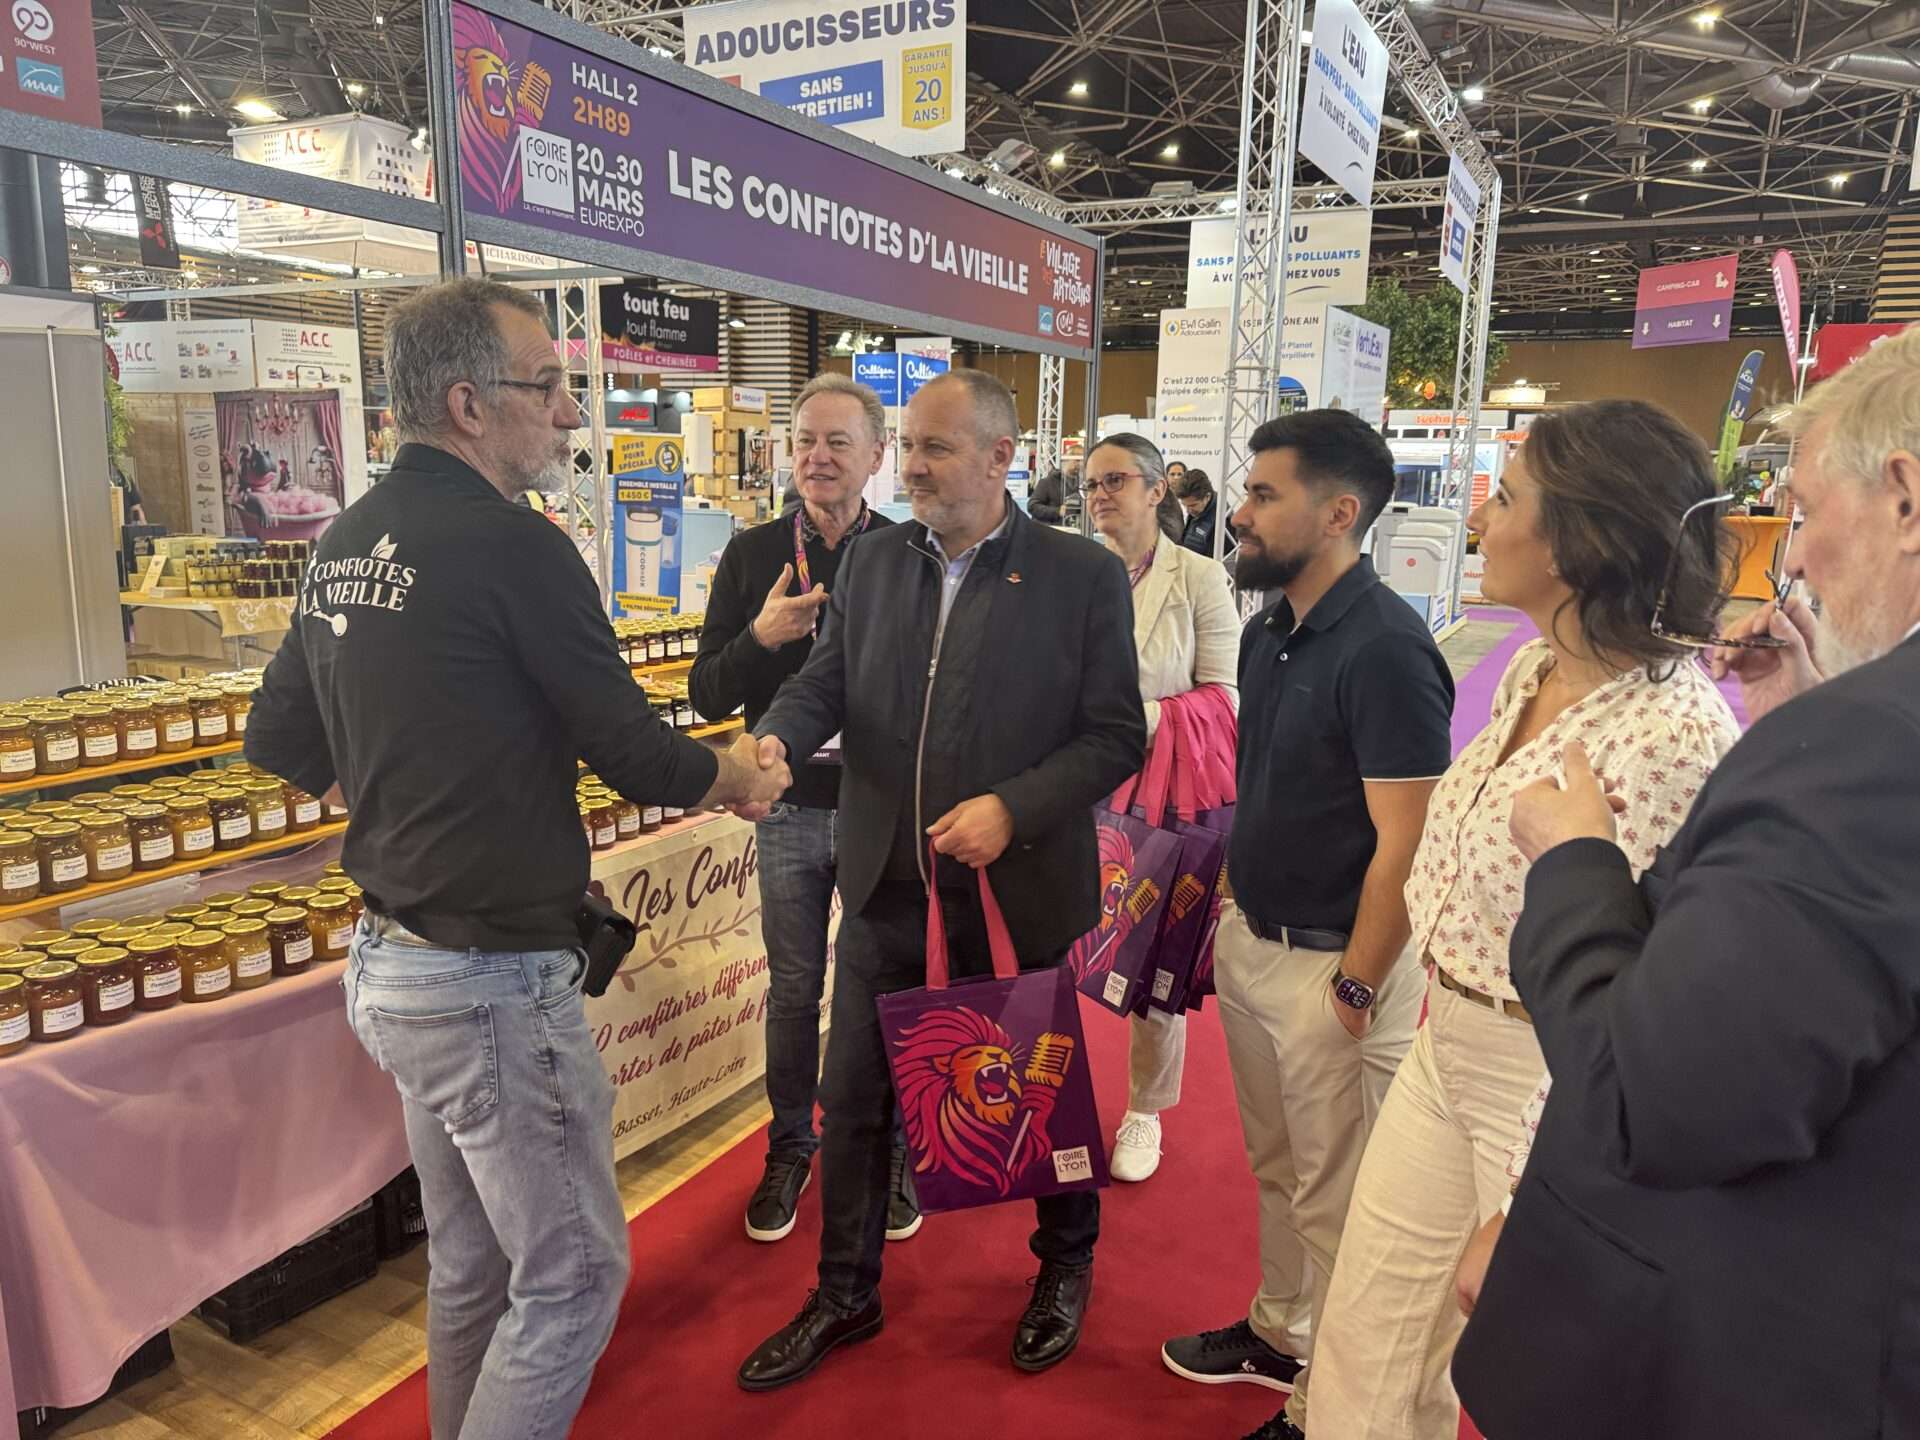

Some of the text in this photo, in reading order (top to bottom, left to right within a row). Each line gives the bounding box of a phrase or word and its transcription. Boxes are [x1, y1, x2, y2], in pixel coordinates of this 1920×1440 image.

[695, 0, 956, 66] ADOUCISSEURS
[904, 48, 950, 63] GARANTIE
[1342, 24, 1368, 79] L'EAU
[572, 62, 639, 106] HALL 2
[800, 76, 843, 98] SANS
[915, 79, 942, 103] 20
[573, 96, 631, 136] 2H89
[913, 108, 940, 122] ANS
[526, 136, 568, 164] FOIRE
[527, 158, 568, 186] LYON
[578, 176, 645, 217] MARS
[580, 207, 645, 237] EUREXPO
[669, 149, 734, 210] LES
[743, 175, 903, 259] CONFIOTES
[961, 245, 1028, 295] VIEILLE
[1250, 226, 1308, 245] L'U
[485, 247, 545, 266] ICHARDSON
[1046, 240, 1081, 280] VILLAGE
[1197, 257, 1225, 267] SANS
[1295, 250, 1361, 262] POLLUANTS
[1311, 268, 1341, 278] VOUS
[1656, 280, 1700, 292] CAMPING-CAR
[1053, 276, 1091, 308] ARTISANS
[623, 291, 690, 321] tout feu
[626, 319, 687, 342] tout flamme
[1303, 317, 1319, 325] AIN
[1668, 320, 1693, 328] HABITAT
[1281, 351, 1315, 360] erpillière
[858, 364, 896, 376] Culligan
[1185, 377, 1194, 385] 22
[314, 557, 417, 587] CONFIOTES
[326, 580, 408, 612] VIEILLE
[623, 835, 758, 935] Les Confi
[617, 986, 709, 1040] confitures
[712, 954, 768, 1000] différen
[659, 1037, 683, 1067] de
[684, 1015, 733, 1063] pâtes
[736, 998, 755, 1027] de
[614, 1056, 747, 1139] Basset, Haute-Loire
[1057, 1150, 1086, 1162] FOIRE
[1058, 1160, 1087, 1173] LYON
